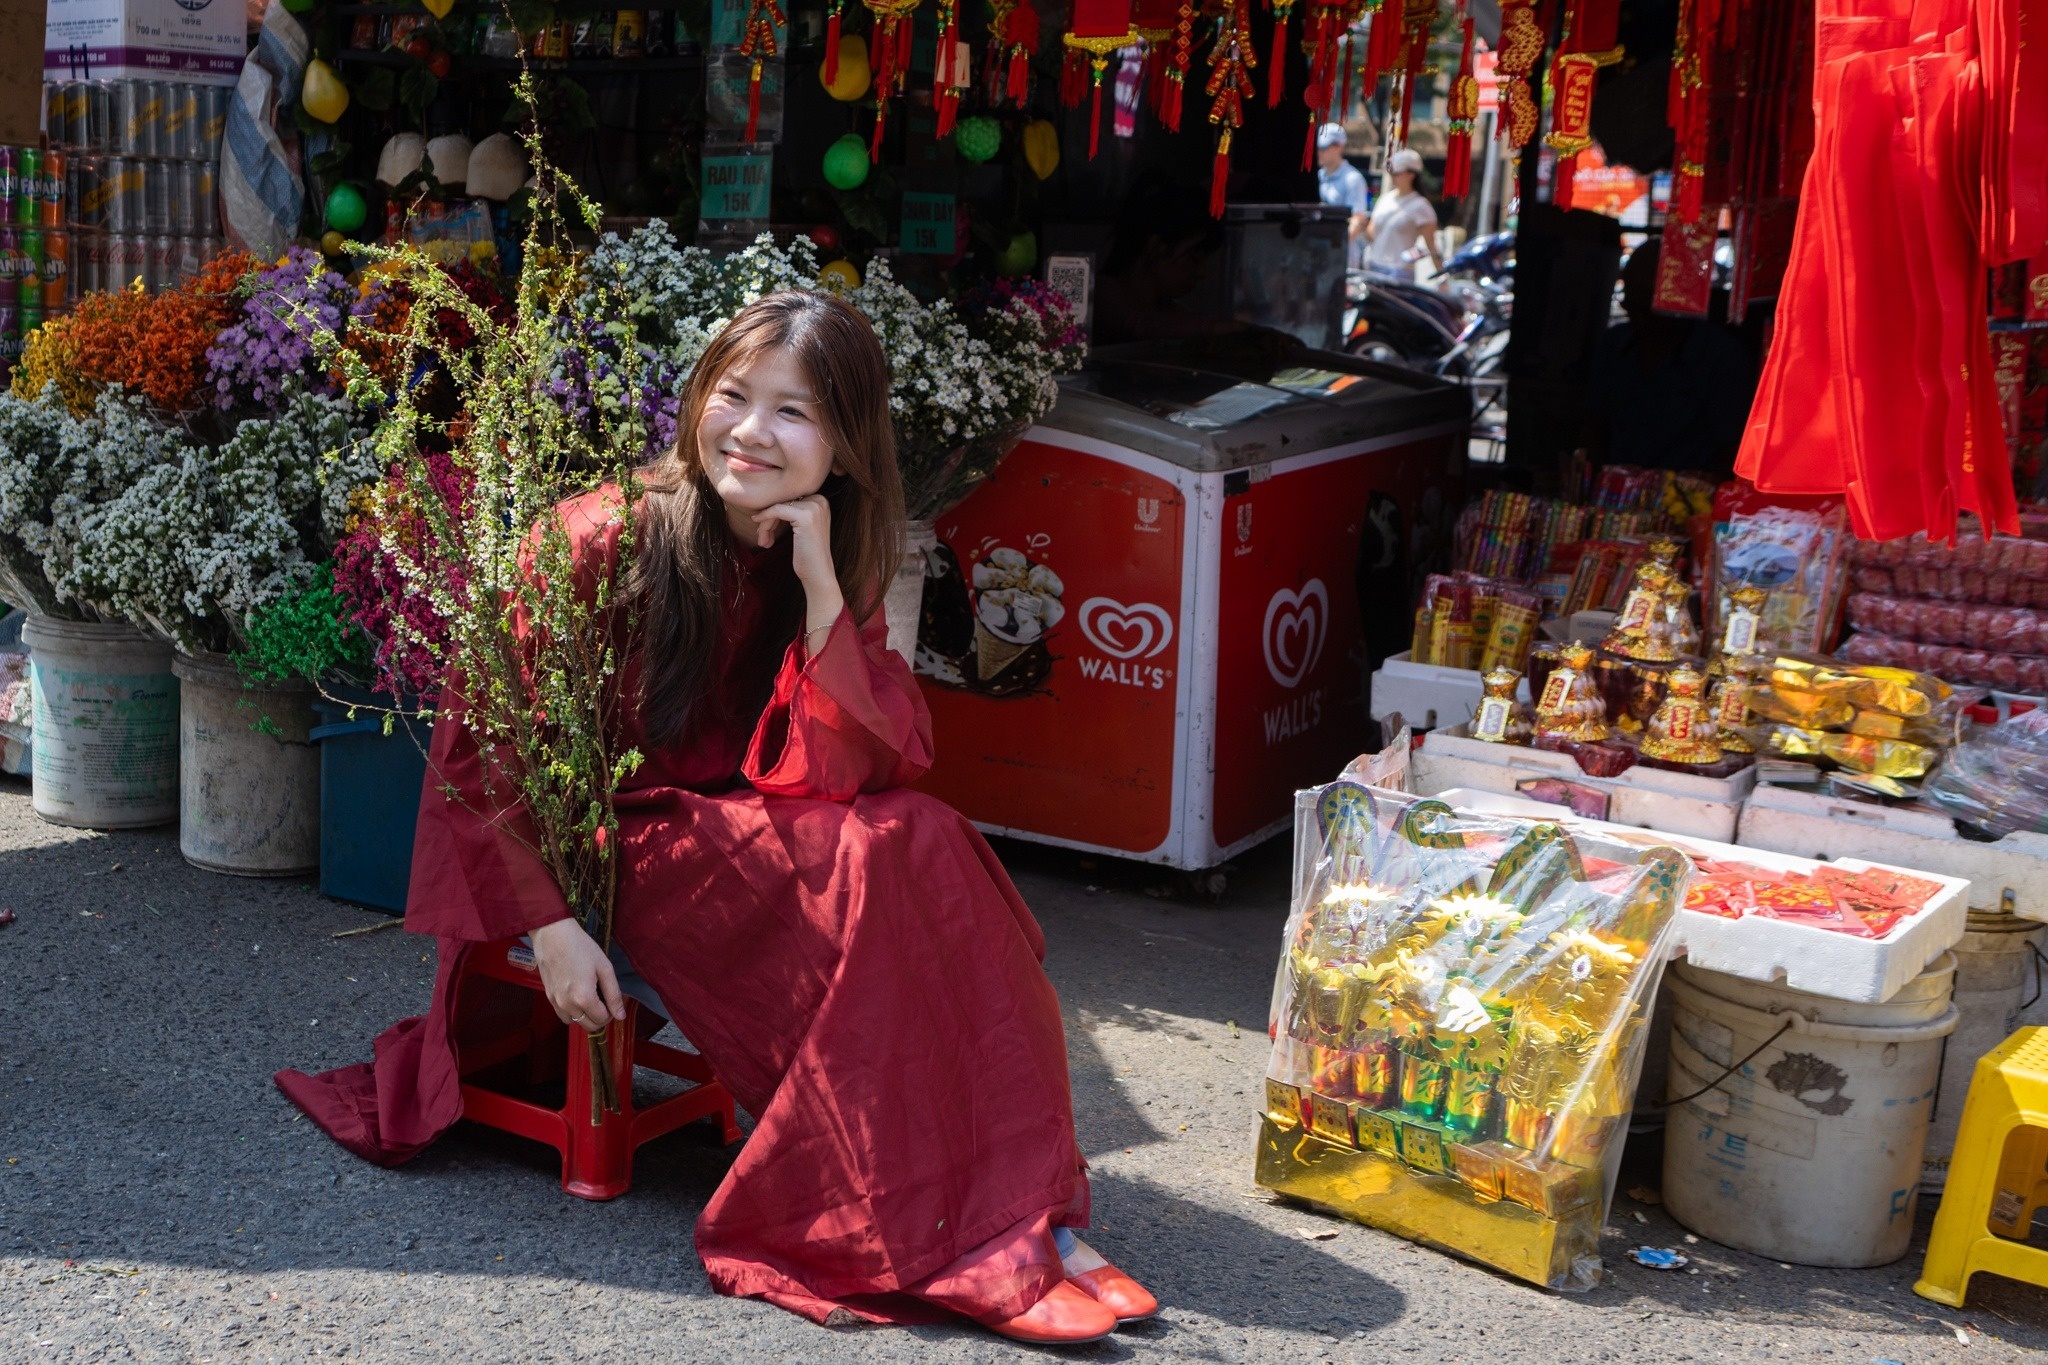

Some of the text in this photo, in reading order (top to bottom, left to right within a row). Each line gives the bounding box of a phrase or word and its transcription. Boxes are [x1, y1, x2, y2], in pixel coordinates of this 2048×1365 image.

[181, 17, 202, 26] 1898
[707, 165, 738, 185] RAU
[723, 192, 751, 212] 15K
[914, 228, 938, 249] 15K
[1078, 655, 1166, 691] WALL'S
[1263, 689, 1322, 748] WALL'S
